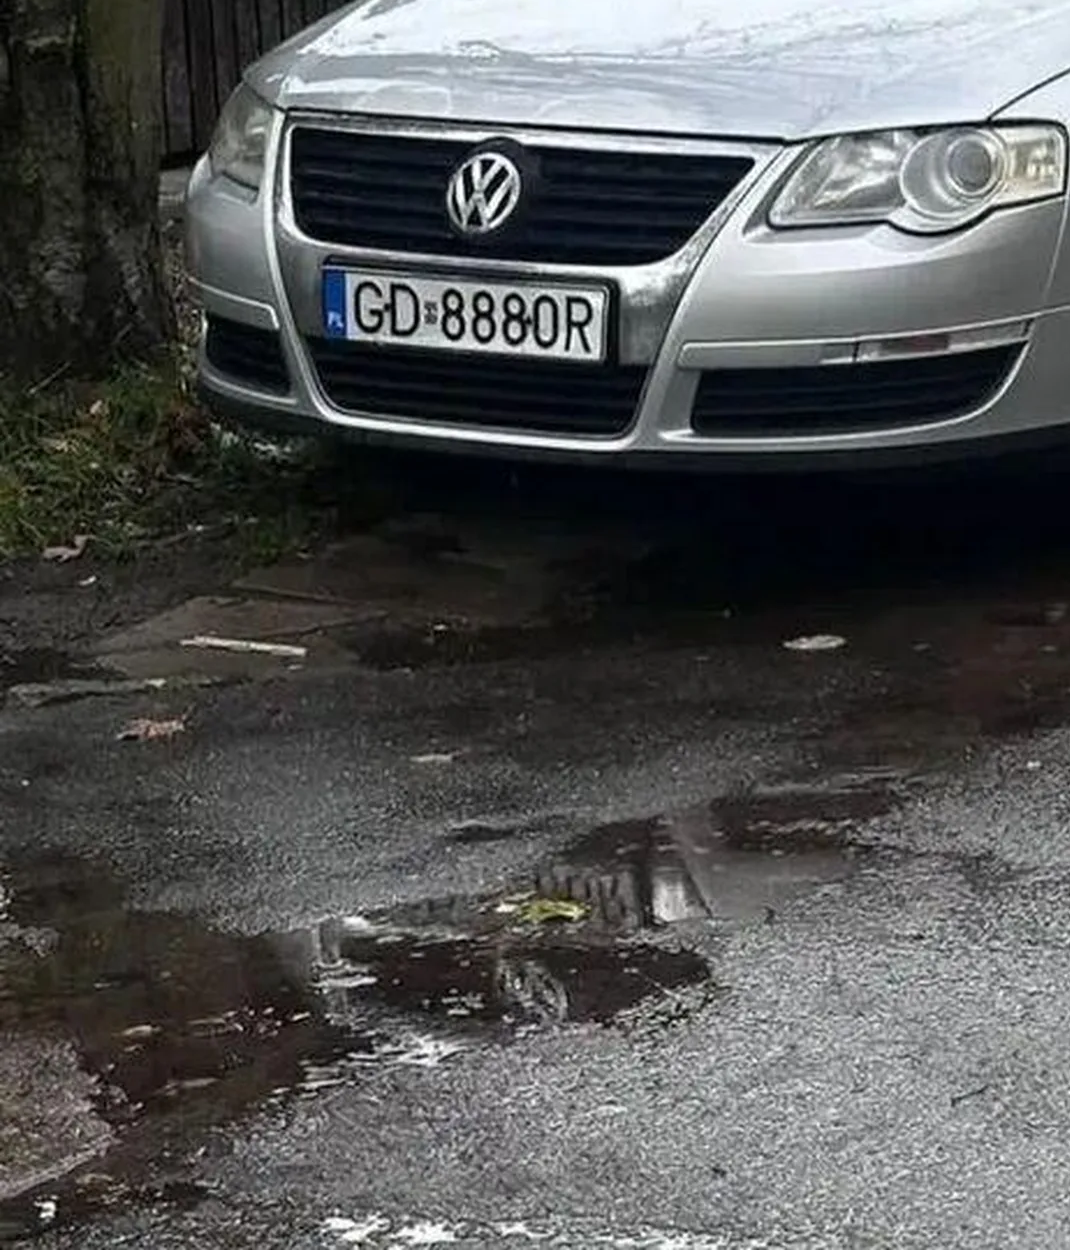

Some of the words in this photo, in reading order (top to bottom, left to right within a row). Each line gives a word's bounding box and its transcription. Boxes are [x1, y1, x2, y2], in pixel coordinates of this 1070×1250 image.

[447, 152, 521, 233] VW
[327, 311, 344, 329] PL
[354, 281, 420, 337] GD
[441, 288, 593, 353] 8880R
